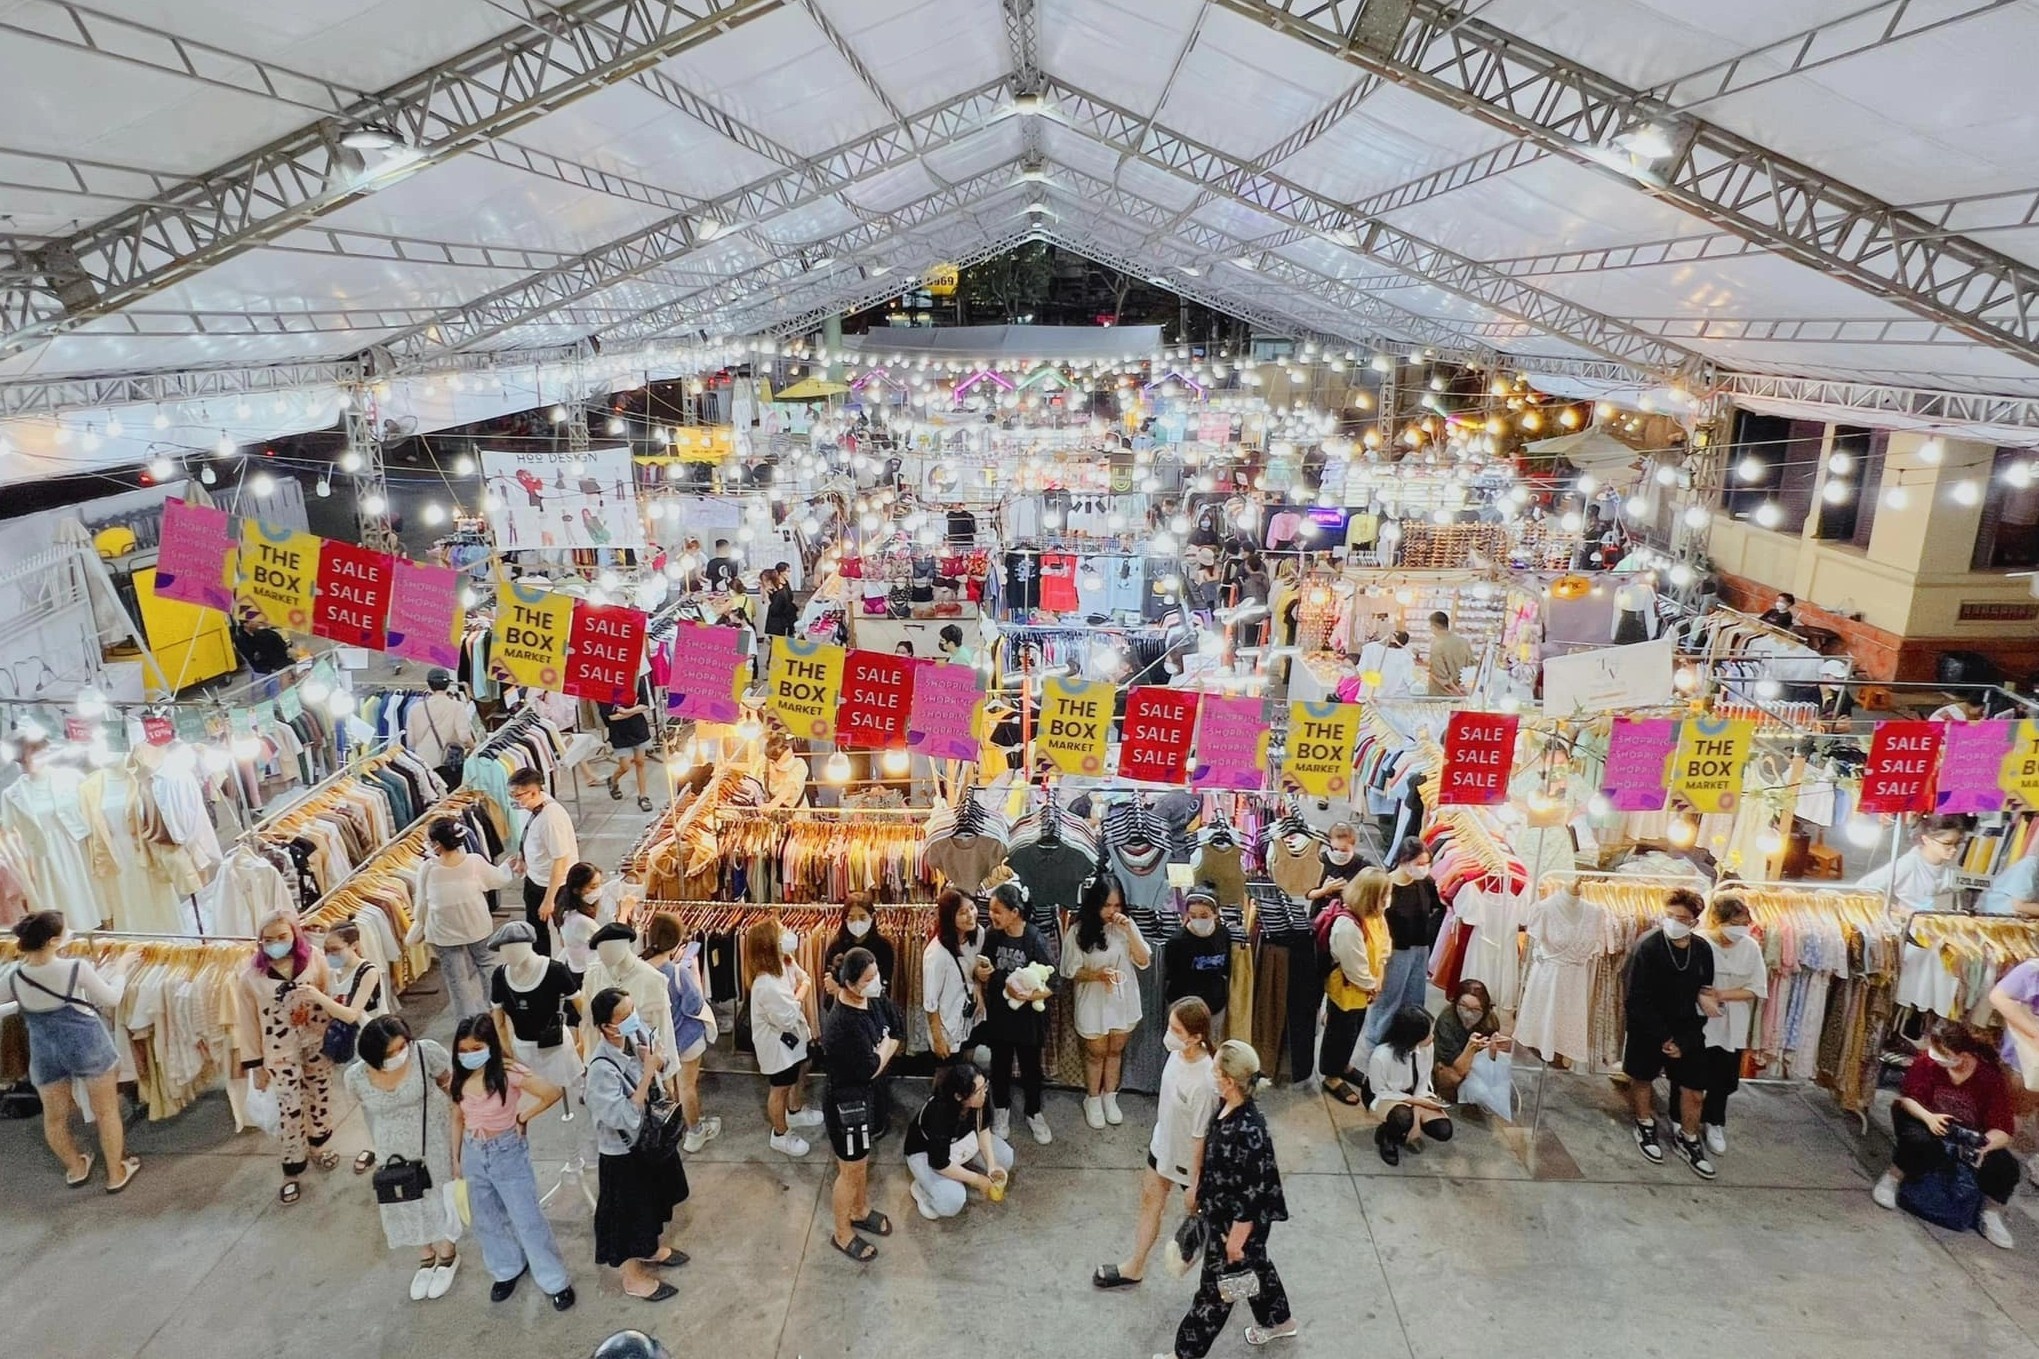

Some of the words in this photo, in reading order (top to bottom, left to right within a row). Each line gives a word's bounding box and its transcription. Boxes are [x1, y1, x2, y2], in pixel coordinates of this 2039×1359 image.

[549, 453, 598, 464] DESIGN
[258, 544, 300, 570] THE
[254, 565, 300, 593] BOX
[331, 557, 379, 583] SALE
[252, 586, 300, 606] MARKET
[329, 581, 377, 607] SALE
[327, 605, 373, 630] SALE
[513, 604, 554, 630] THE
[585, 616, 632, 639] SALE
[506, 627, 554, 652] BOX
[685, 639, 738, 656] SHOPPING
[503, 647, 552, 665] MARKET
[582, 639, 629, 663] SALE
[683, 654, 735, 671] SHOPPING
[785, 658, 827, 681] THE
[579, 662, 626, 686] SALE
[682, 669, 733, 687] SHOPPING
[856, 665, 901, 686] SALE
[680, 685, 732, 701] SHOPPING
[778, 680, 826, 703] BOX
[925, 678, 976, 693] SHOPPING
[854, 688, 898, 709] SALE
[923, 694, 972, 708] SHOPPING
[778, 700, 824, 716] MARKET
[921, 710, 972, 724] SHOPPING
[1057, 698, 1099, 718] THE
[1138, 702, 1184, 721] SALE
[851, 711, 896, 732] SALE
[1211, 711, 1262, 725] SHOPPING
[920, 723, 970, 738] SHOPPING
[1050, 719, 1097, 740] BOX
[1135, 725, 1180, 745] SALE
[1208, 726, 1258, 739] SHOPPING
[1303, 721, 1344, 741] THE
[1459, 725, 1504, 742] SALE
[1048, 739, 1094, 753] MARKET
[1206, 742, 1255, 754] SHOPPING
[1618, 735, 1670, 747] SHOPPING
[1694, 739, 1734, 757] THE
[1886, 736, 1932, 752] SALE
[1132, 748, 1177, 767] SALE
[1297, 742, 1342, 762] BOX
[1455, 748, 1500, 766] SALE
[1204, 757, 1253, 769] SHOPPING
[1294, 762, 1339, 775] MARKET
[1687, 760, 1732, 777] BOX
[1880, 758, 1927, 775] SALE
[1452, 771, 1497, 788] SALE
[1685, 780, 1730, 792] MARKET
[1875, 781, 1921, 797] SALE
